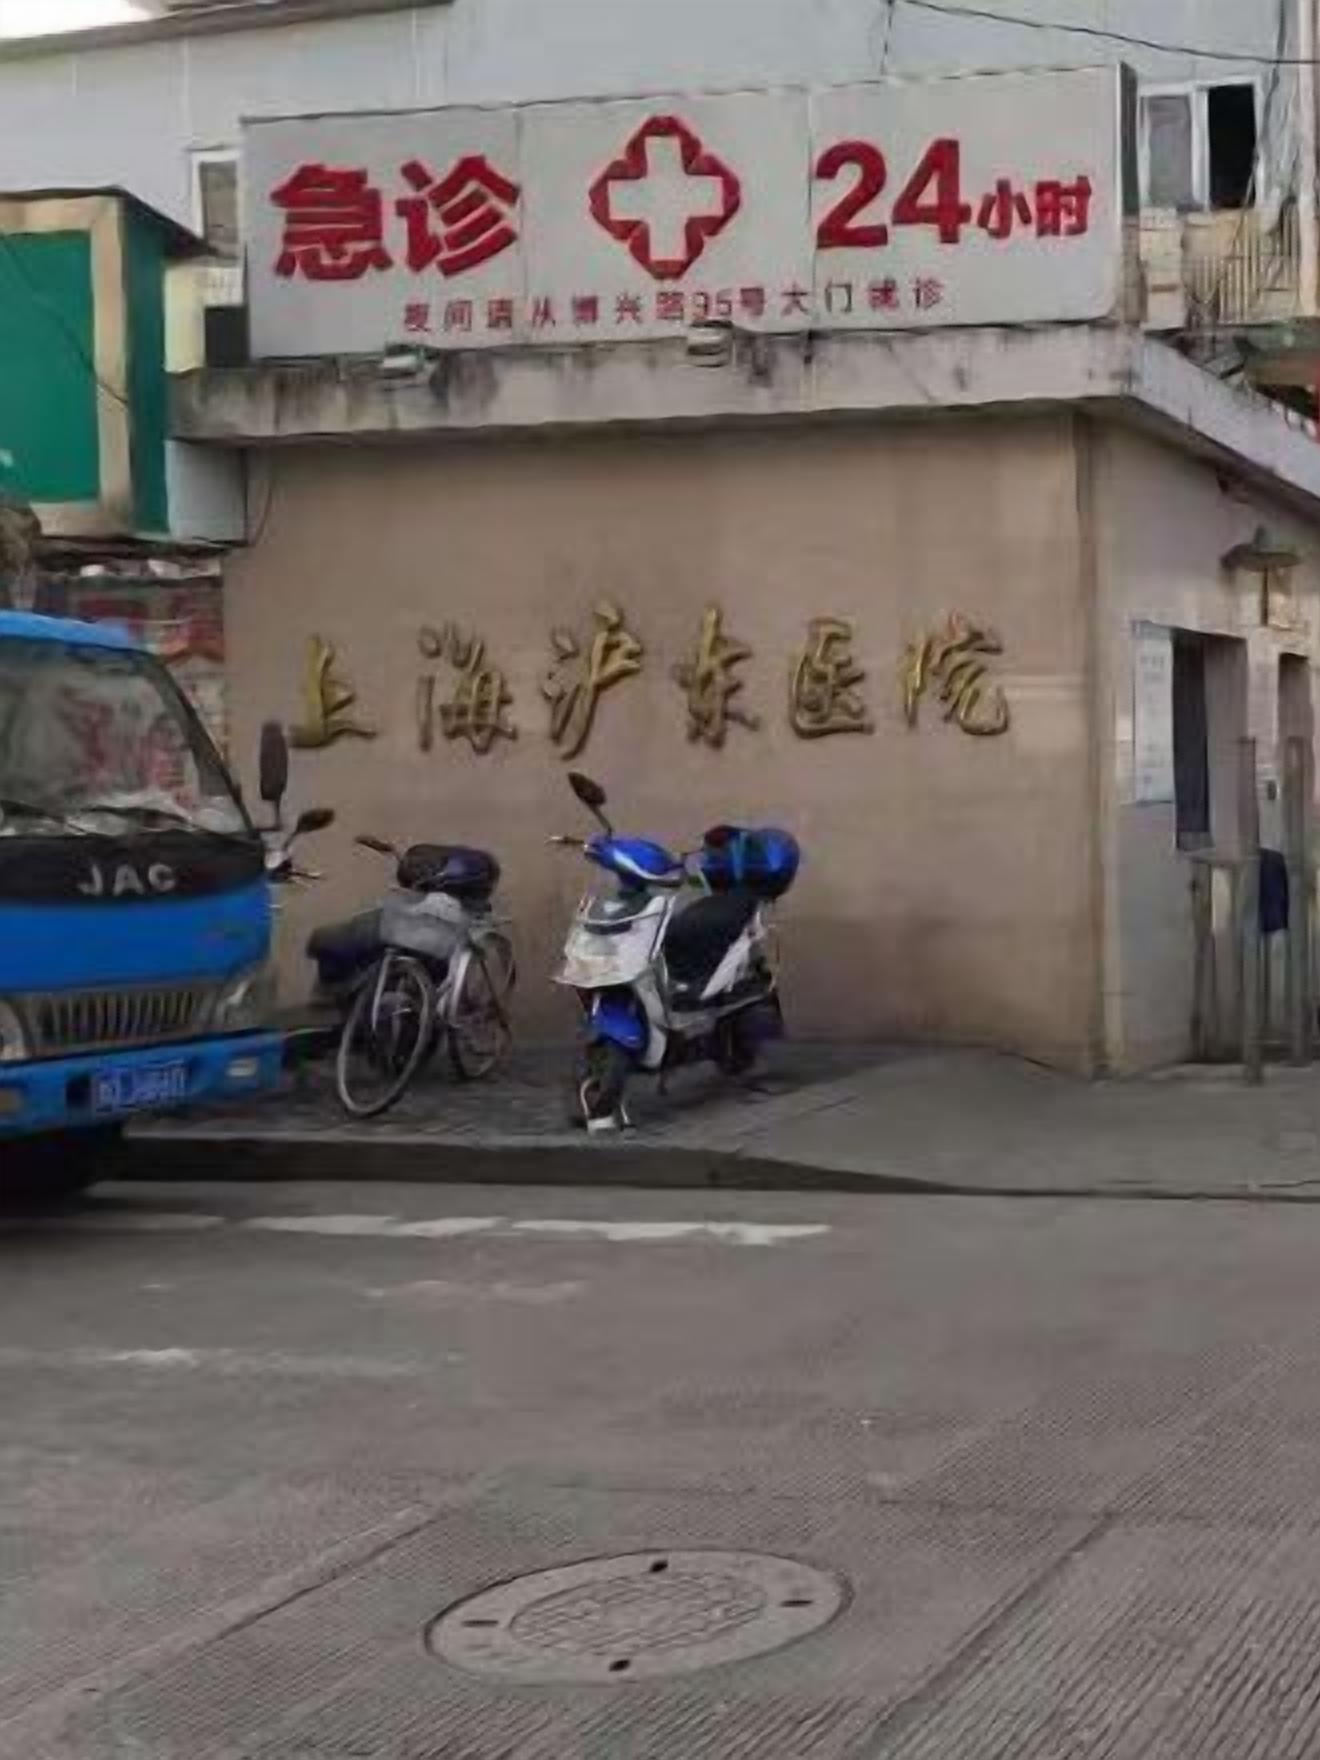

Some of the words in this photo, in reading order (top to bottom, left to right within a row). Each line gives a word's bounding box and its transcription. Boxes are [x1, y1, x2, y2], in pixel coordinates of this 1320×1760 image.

[270, 153, 521, 281] 急诊
[816, 138, 1093, 249] 24小时
[289, 600, 1010, 761] 上海沪东医院
[77, 862, 177, 897] JAC
